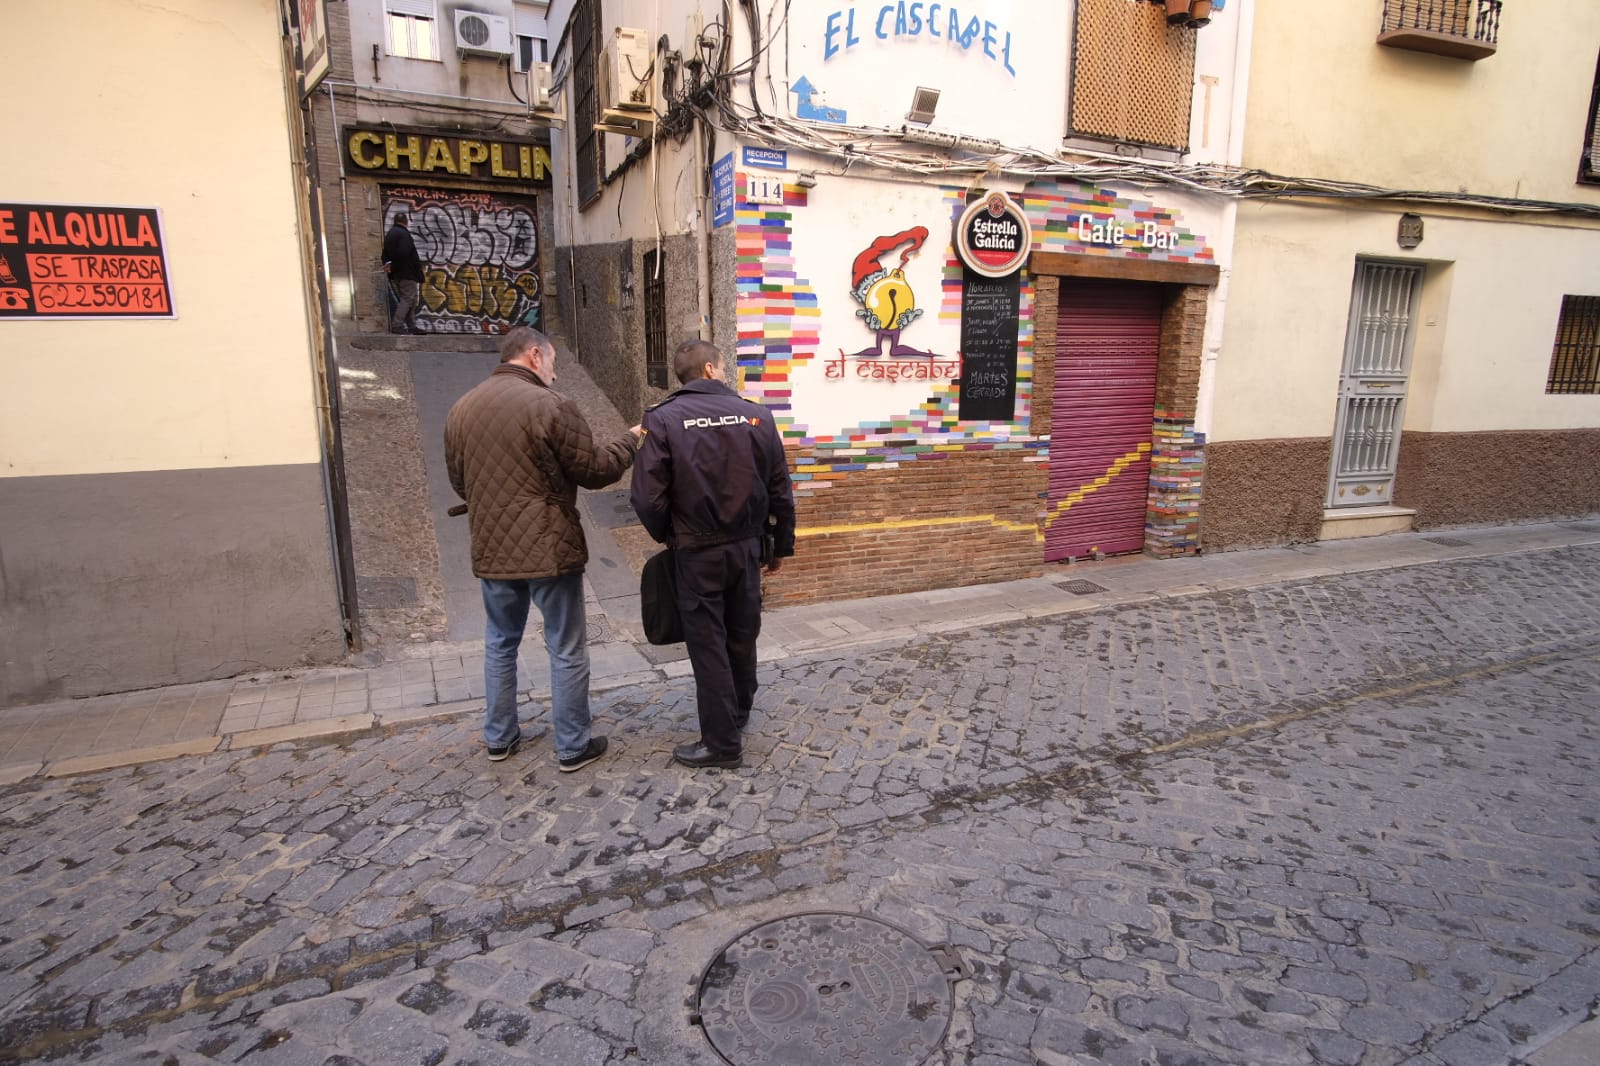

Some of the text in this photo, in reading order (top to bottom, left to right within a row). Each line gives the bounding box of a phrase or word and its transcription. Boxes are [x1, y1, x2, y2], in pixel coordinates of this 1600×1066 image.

[824, 0, 1016, 77] EL CASCABEL
[349, 131, 553, 181] CHAPLIN
[746, 149, 784, 160] RECEPCIÓN
[751, 181, 781, 198] 114
[0, 210, 159, 248] E ALQUILA
[973, 218, 1017, 235] Estrella
[1078, 214, 1124, 245] Café
[1142, 221, 1179, 250] Bar
[975, 233, 1015, 250] Galicia
[34, 256, 164, 281] SE TRASPASA
[39, 284, 164, 308] 622590181
[824, 348, 964, 383] el cascabel
[683, 415, 749, 430] POLICIA
